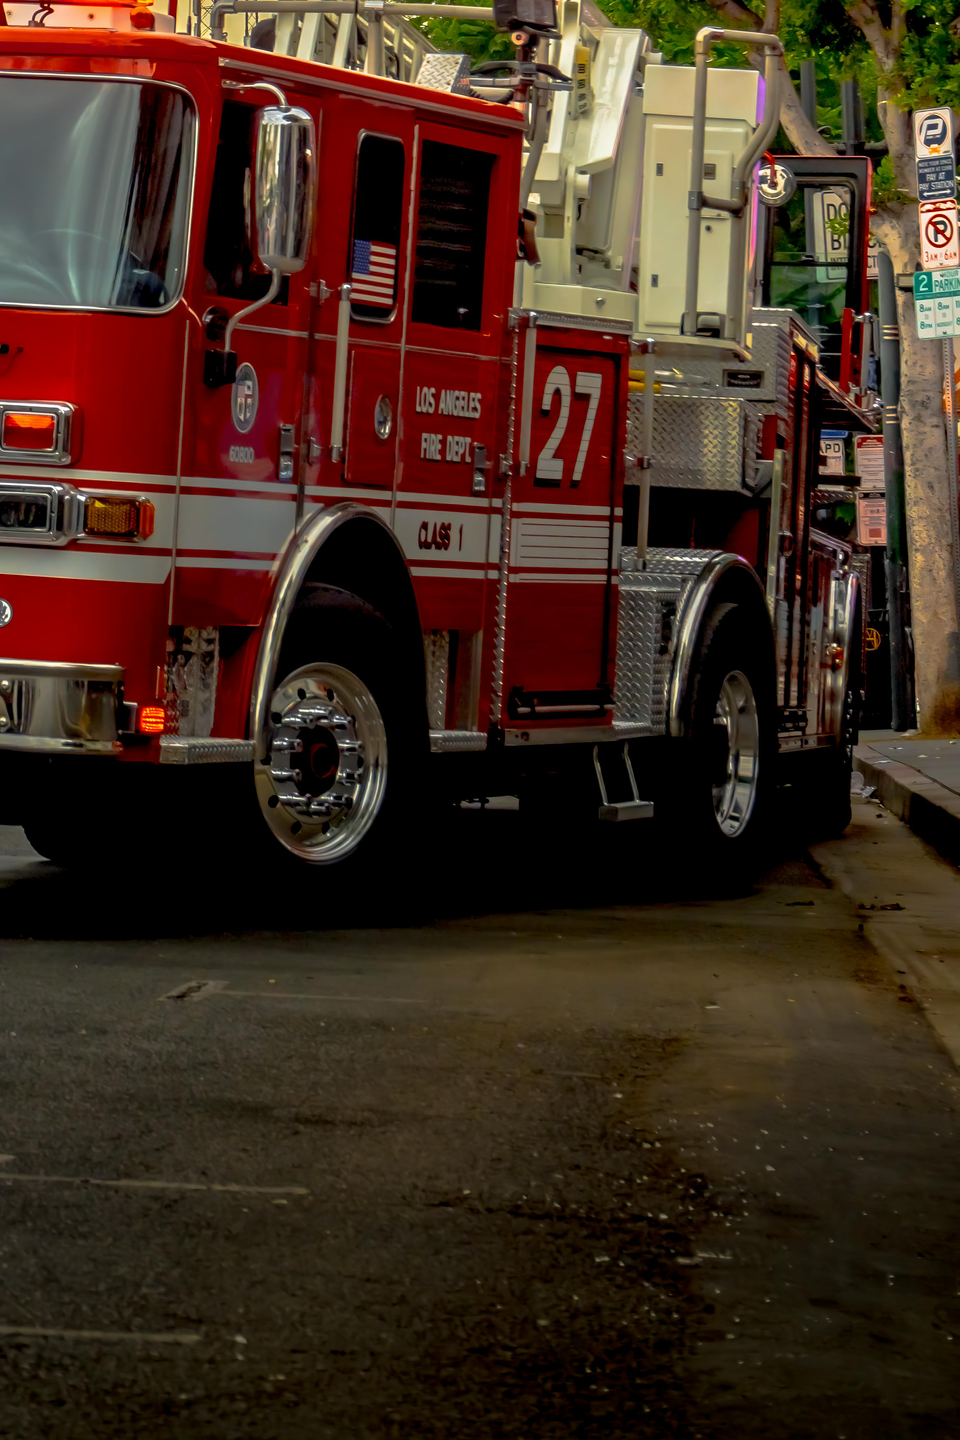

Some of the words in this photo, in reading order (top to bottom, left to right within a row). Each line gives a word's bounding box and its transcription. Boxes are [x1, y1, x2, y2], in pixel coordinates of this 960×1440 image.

[919, 182, 930, 192] PAY
[931, 180, 954, 190] STATION
[926, 173, 937, 181] PAY
[938, 172, 946, 180] AT
[919, 275, 928, 291] 2
[934, 278, 960, 291] PARKIN
[416, 386, 436, 414] LOS
[439, 389, 482, 419] ANGELES
[536, 366, 602, 481] 27
[421, 433, 442, 460] FIRE
[446, 435, 472, 463] DEPT.
[418, 521, 452, 551] CLASS
[458, 523, 464, 552] 1
